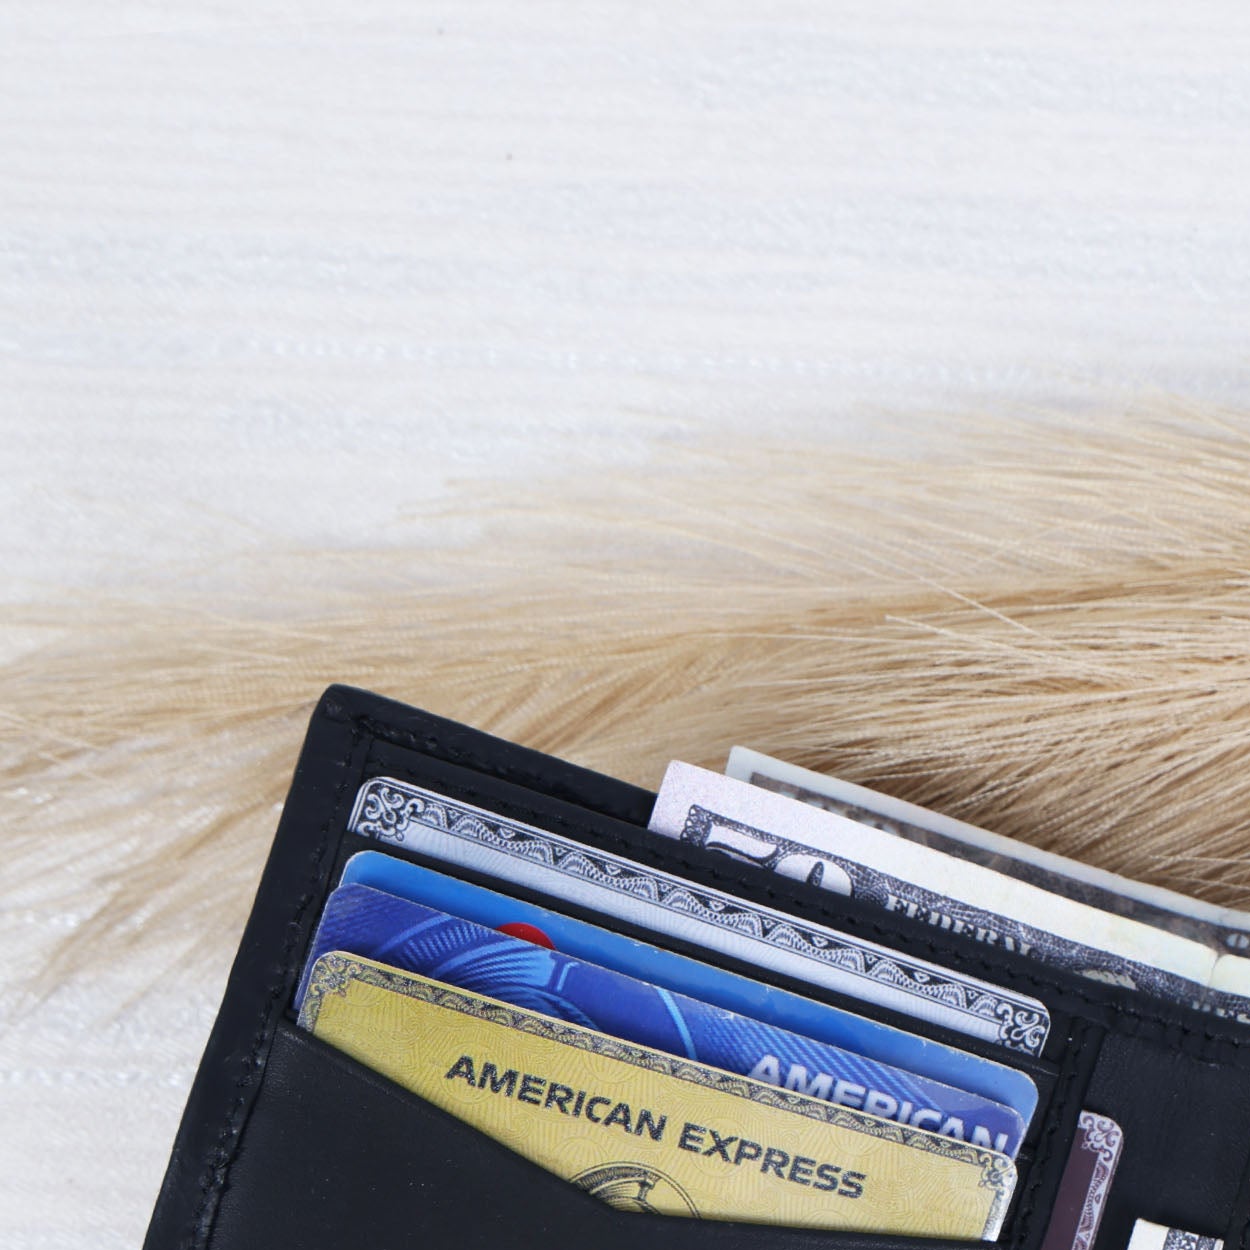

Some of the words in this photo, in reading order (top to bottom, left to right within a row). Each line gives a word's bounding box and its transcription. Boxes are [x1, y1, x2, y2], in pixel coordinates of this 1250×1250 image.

[444, 1055, 667, 1141] AMERICAN
[678, 1122, 866, 1199] EXPRESS
[747, 1053, 1009, 1153] AMERICAN
